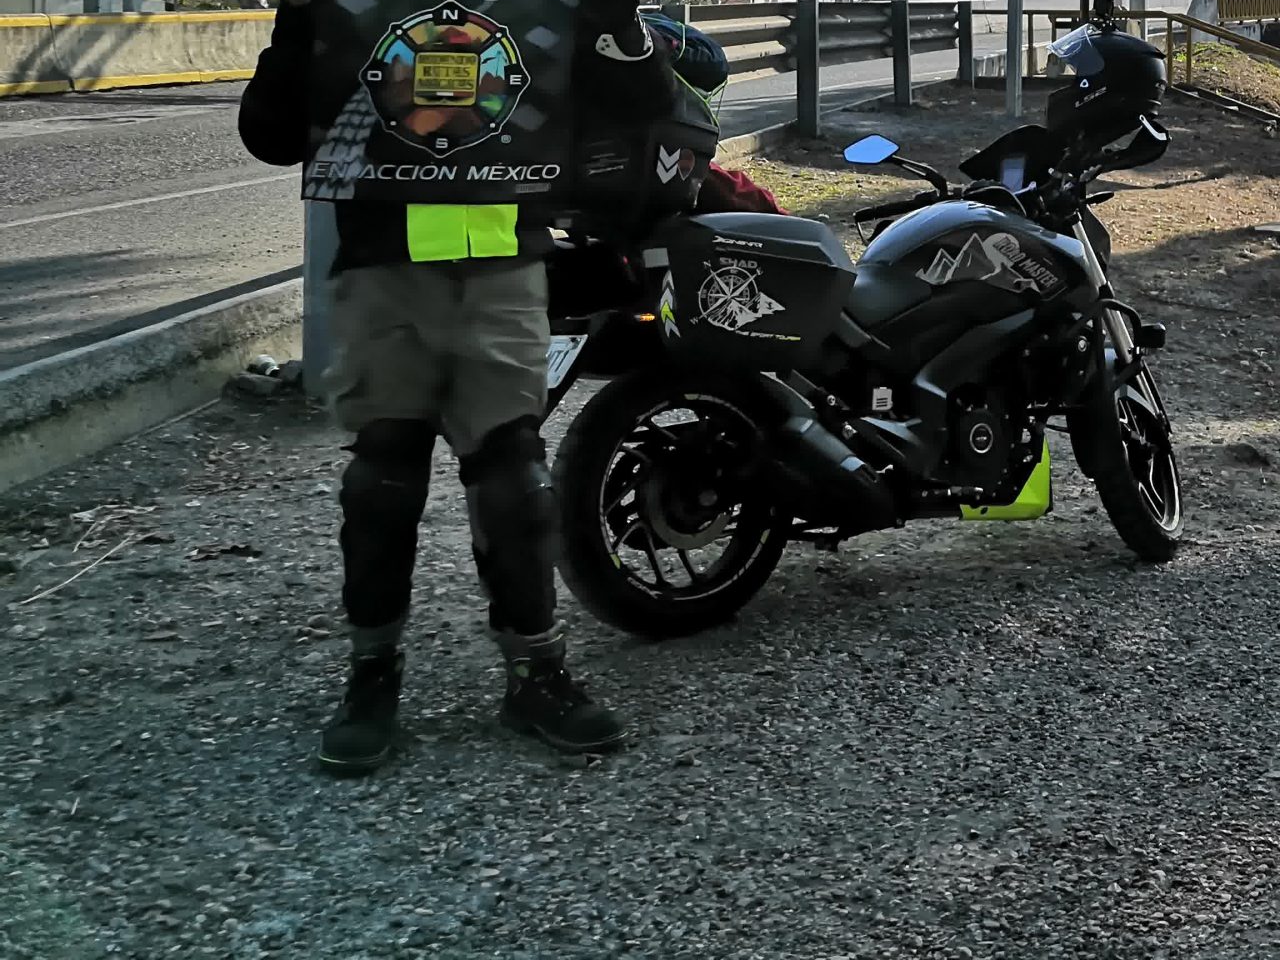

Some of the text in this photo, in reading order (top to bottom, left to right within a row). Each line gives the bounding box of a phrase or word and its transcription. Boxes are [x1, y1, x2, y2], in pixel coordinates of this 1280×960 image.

[442, 8, 459, 20] N
[509, 74, 522, 86] E
[311, 162, 561, 181] EN ACCIÓN MÉXICO
[1018, 257, 1059, 289] MASTER
